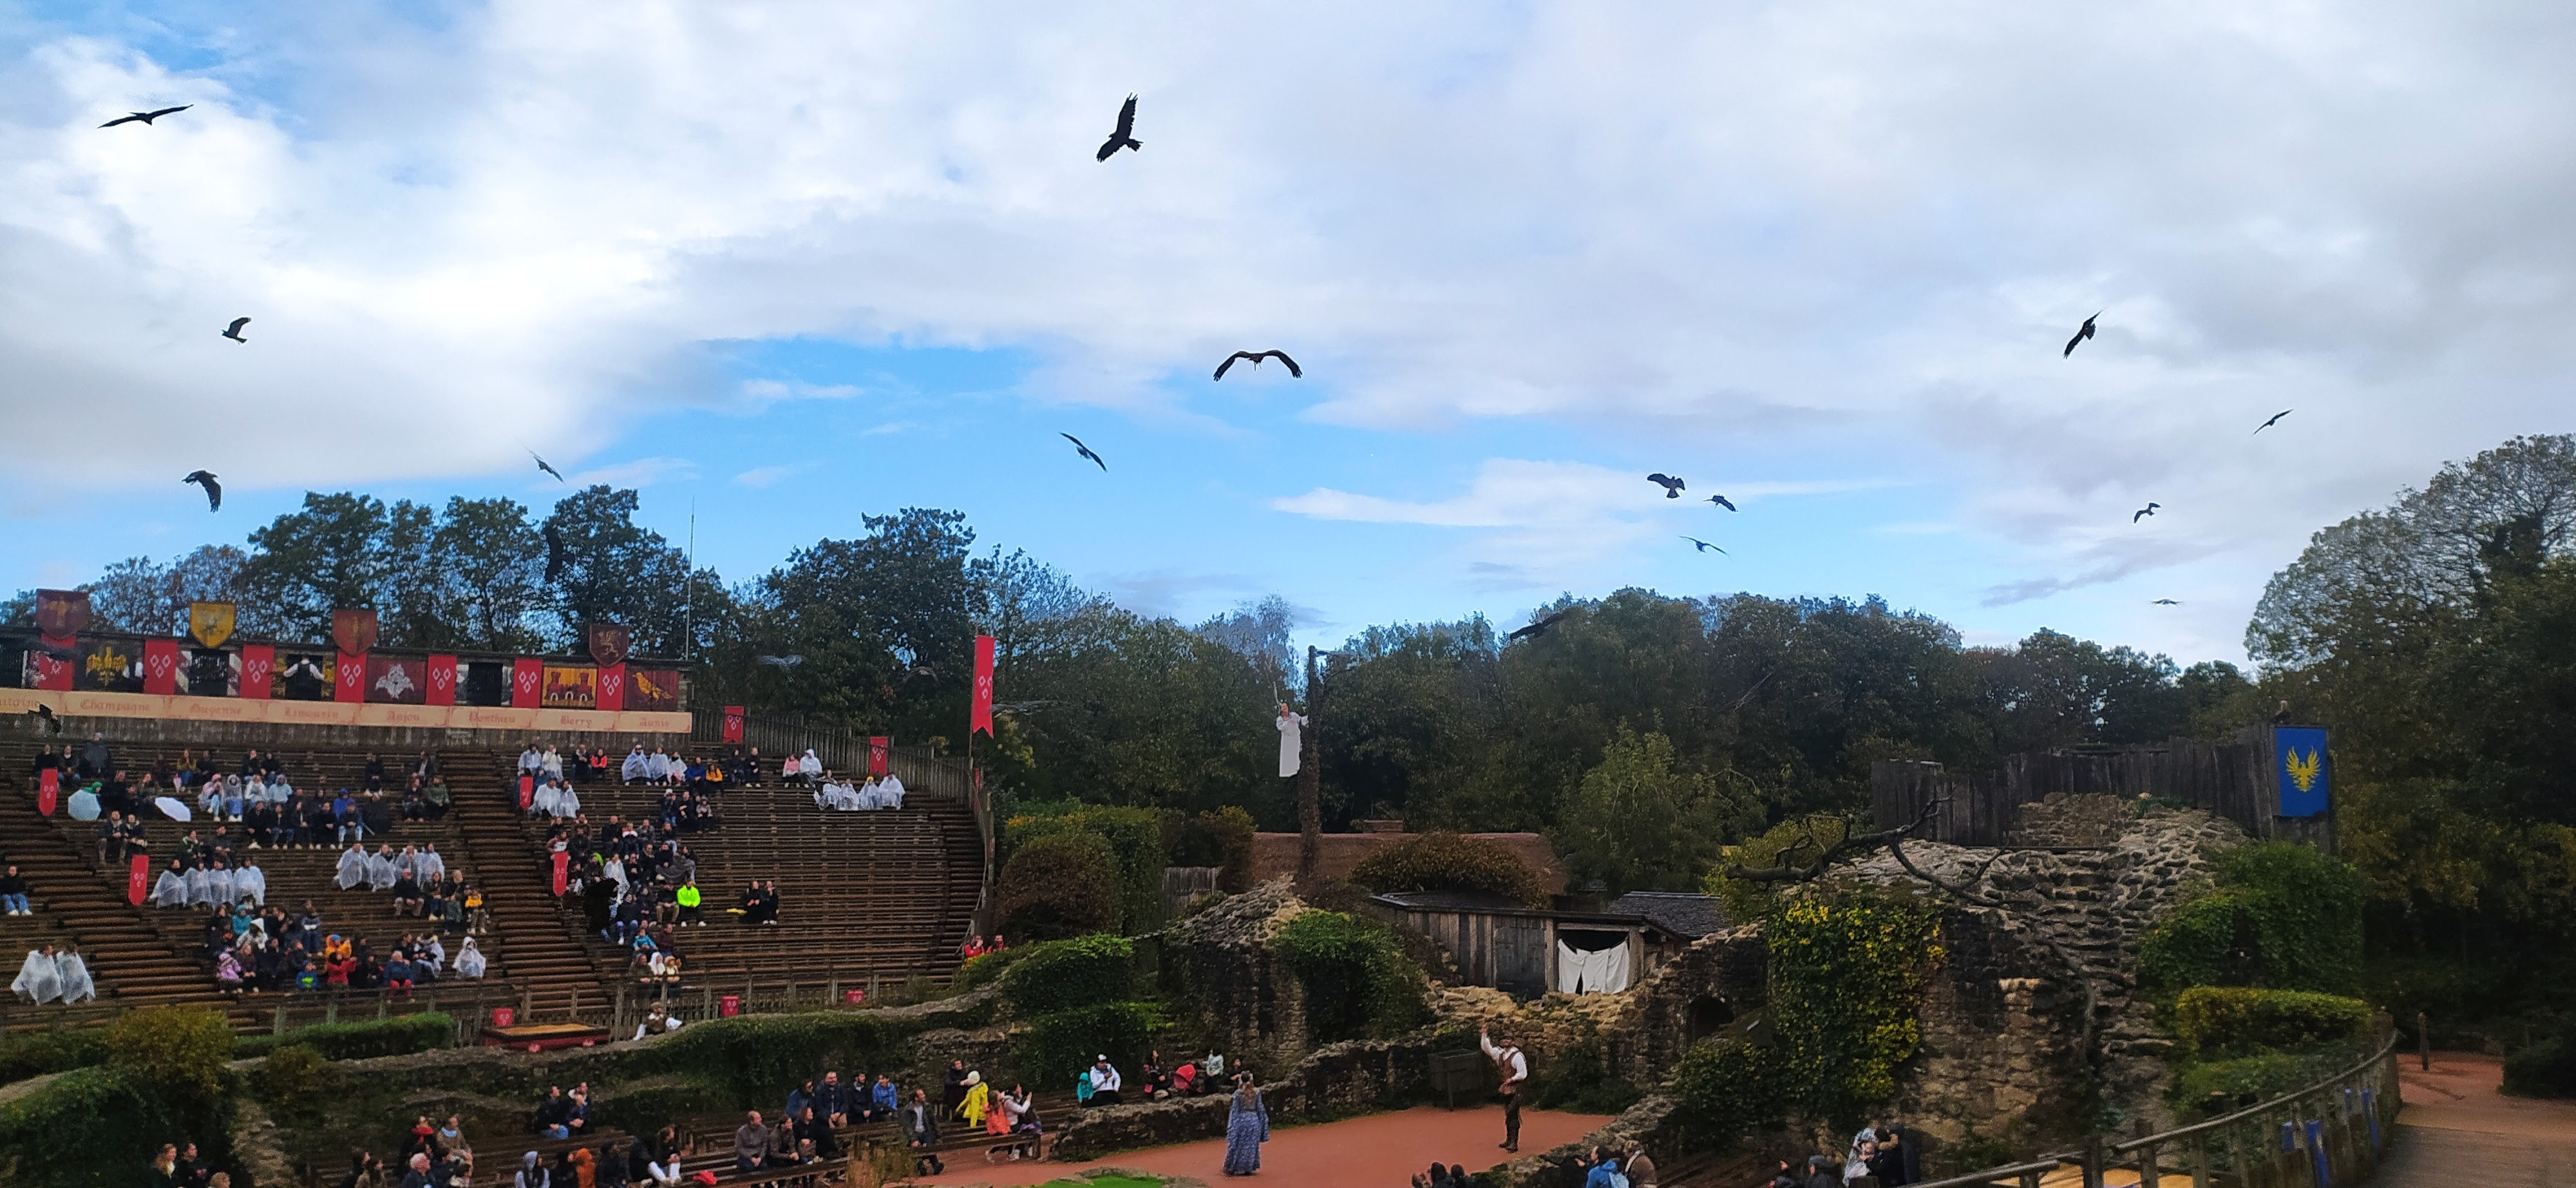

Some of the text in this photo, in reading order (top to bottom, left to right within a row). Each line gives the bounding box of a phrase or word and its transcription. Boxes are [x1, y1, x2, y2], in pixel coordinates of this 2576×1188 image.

[386, 710, 420, 723] Anjou
[560, 715, 592, 728] Berry
[639, 717, 670, 727] Aunis
